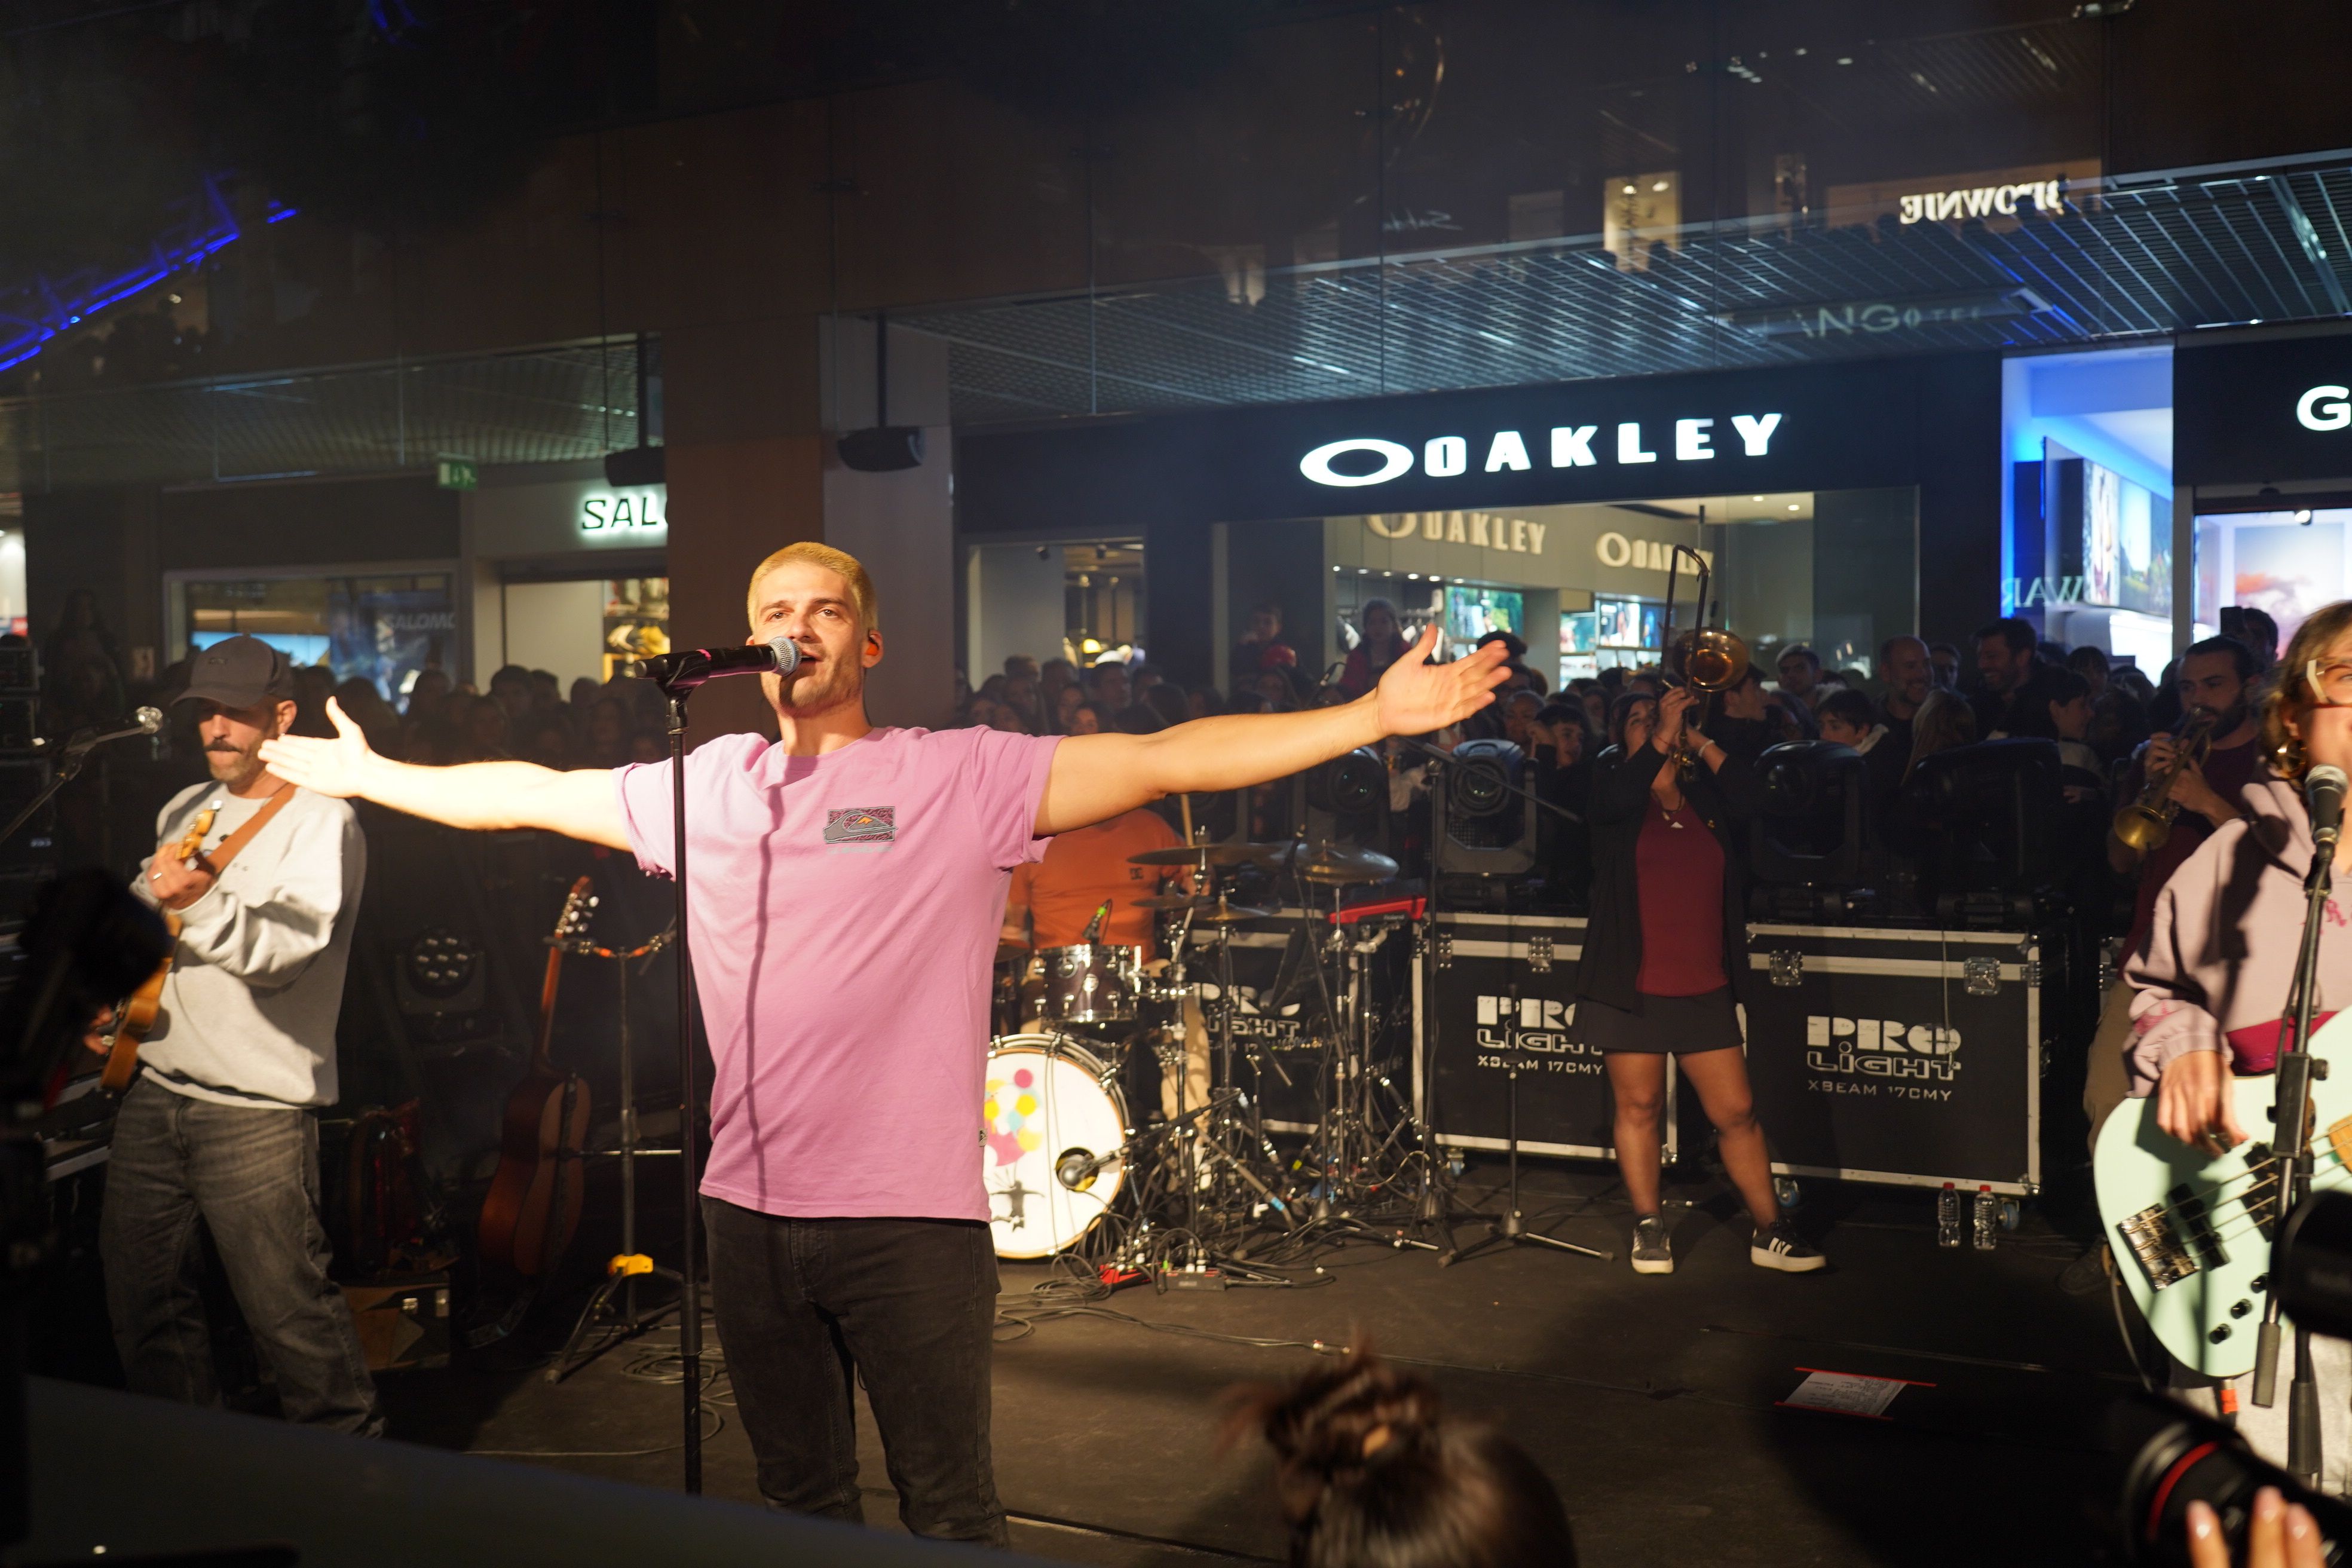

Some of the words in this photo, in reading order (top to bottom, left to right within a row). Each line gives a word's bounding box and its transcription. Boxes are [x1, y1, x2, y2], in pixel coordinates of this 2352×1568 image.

[1425, 413, 1782, 477] OAKLEY
[1423, 511, 1546, 555] OAKLEY
[1477, 996, 1576, 1030] PR
[1807, 1015, 1962, 1055] PRO
[1547, 1060, 1603, 1075] 17CMY
[1807, 1079, 1877, 1096] XBEAM
[1887, 1085, 1952, 1101] 17CMY
